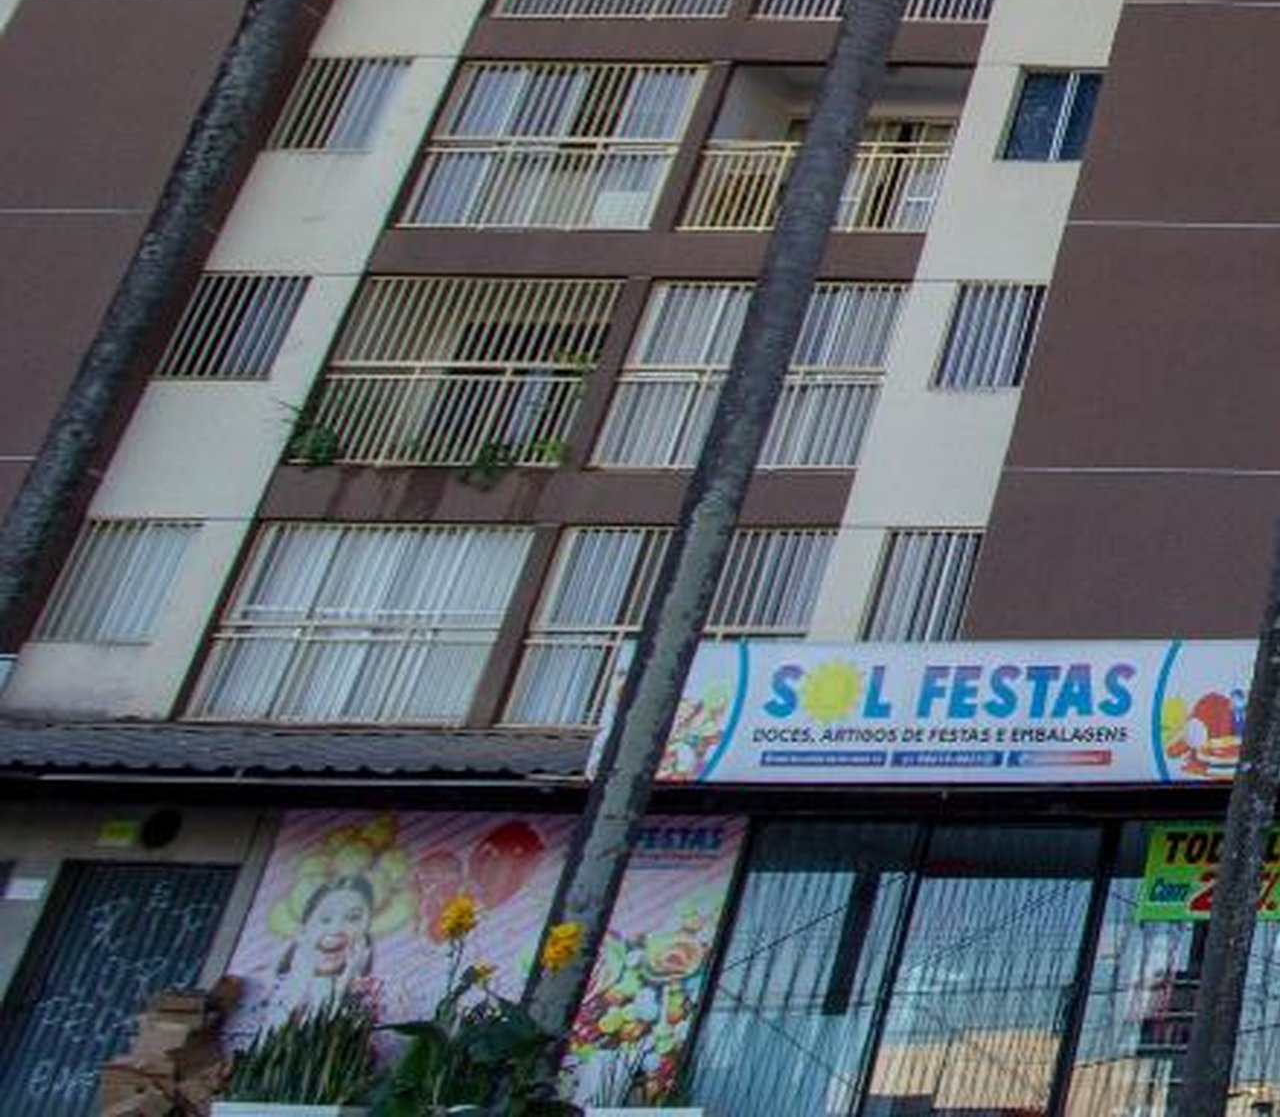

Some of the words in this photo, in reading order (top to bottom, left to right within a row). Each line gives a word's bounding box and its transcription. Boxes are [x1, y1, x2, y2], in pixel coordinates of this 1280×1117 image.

[764, 657, 892, 722] SOL
[917, 663, 1137, 719] FESTAS
[819, 727, 898, 744] ARTIGOS
[901, 727, 923, 744] DE
[927, 727, 989, 744] FESTAS
[995, 727, 1006, 744] E
[1010, 726, 1128, 743] EMBALAGENS
